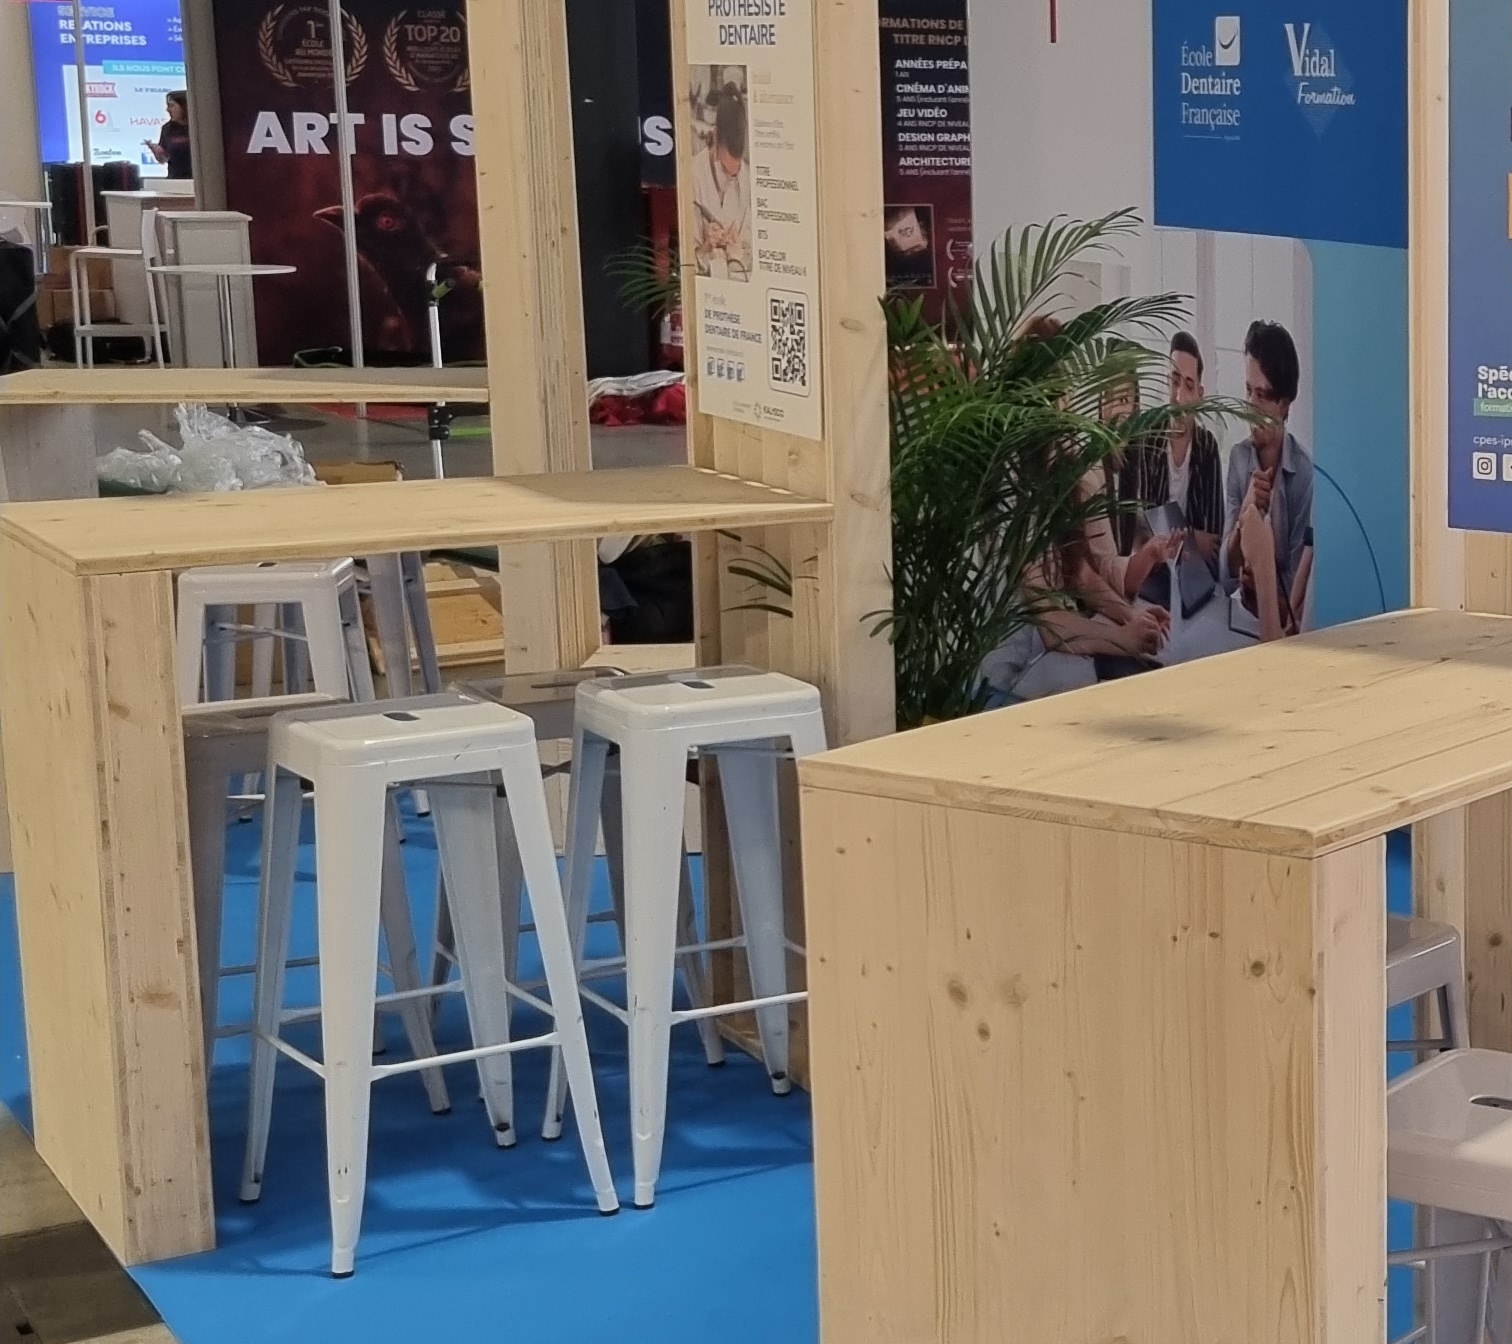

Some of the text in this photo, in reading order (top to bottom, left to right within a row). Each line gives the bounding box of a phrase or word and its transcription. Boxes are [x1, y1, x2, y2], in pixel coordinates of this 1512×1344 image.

[405, 24, 461, 43] TOP 20
[719, 23, 776, 46] DENTAIRE
[893, 33, 926, 45] TITRE
[1181, 41, 1213, 67] École
[1284, 22, 1336, 77] Vidal
[895, 57, 935, 69] ANNÉES
[896, 81, 936, 93] CINÉMA
[1181, 72, 1241, 96] Dentaire
[1297, 82, 1356, 106] Formation
[896, 106, 948, 117] JEU VIDÉO
[1181, 102, 1241, 131] Française
[246, 111, 365, 155] ART
[382, 113, 434, 156] IS
[898, 133, 935, 142] DESIGN
